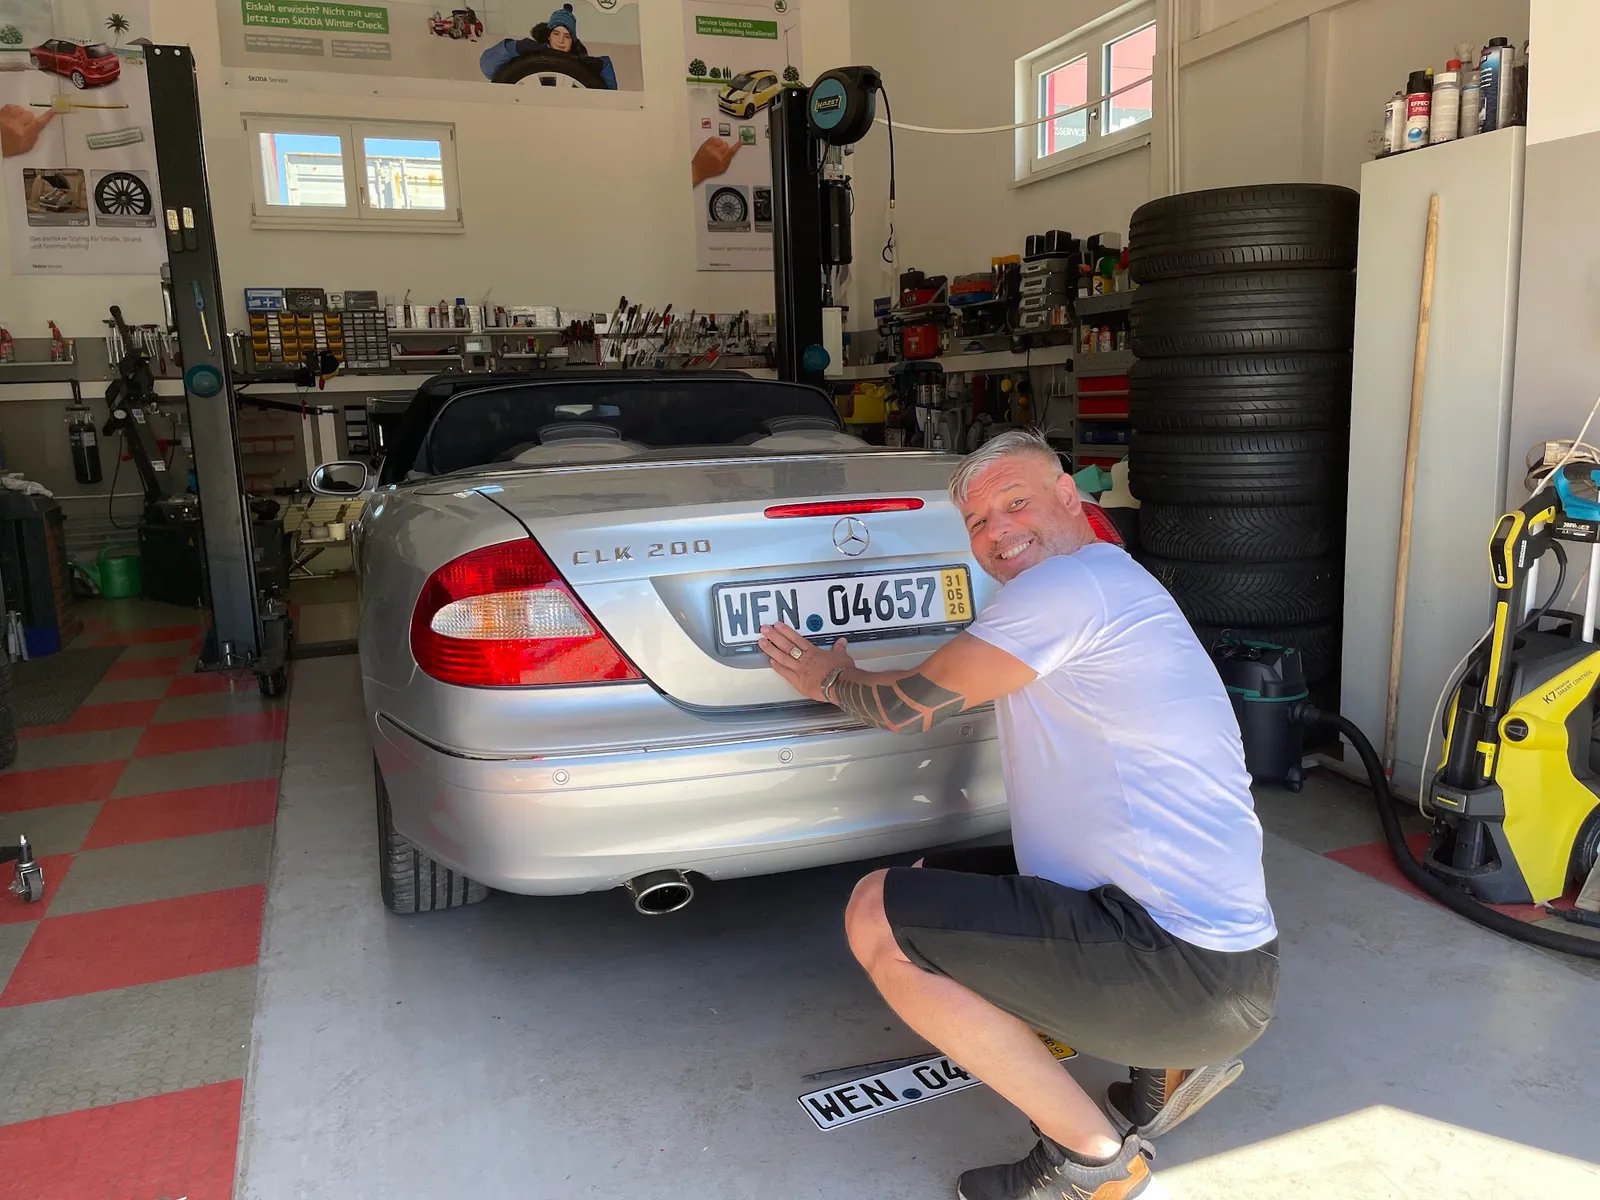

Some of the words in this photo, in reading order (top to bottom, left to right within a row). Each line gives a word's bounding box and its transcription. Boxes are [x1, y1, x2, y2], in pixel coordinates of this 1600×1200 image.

[245, 2, 276, 12] Eiskalt
[278, 4, 320, 15] erwischt?
[322, 7, 345, 16] Nicht
[347, 10, 362, 18] mit
[364, 11, 383, 19] uns!
[246, 14, 269, 23] Jetzt
[292, 15, 323, 27] ŠKODA
[325, 19, 385, 30] Winter-Check.
[718, 20, 737, 28] Update
[816, 97, 840, 110] HAZET
[572, 546, 635, 566] CLK
[647, 539, 712, 559] 200
[945, 574, 961, 587] 31
[827, 576, 936, 626] 04657
[947, 588, 963, 601] 05
[949, 602, 965, 615] 26
[1557, 683, 1574, 696] SMART
[1572, 670, 1593, 686] CONTROL
[1542, 690, 1557, 705] K7
[808, 1079, 899, 1122] WEN
[912, 1059, 971, 1090] 04
